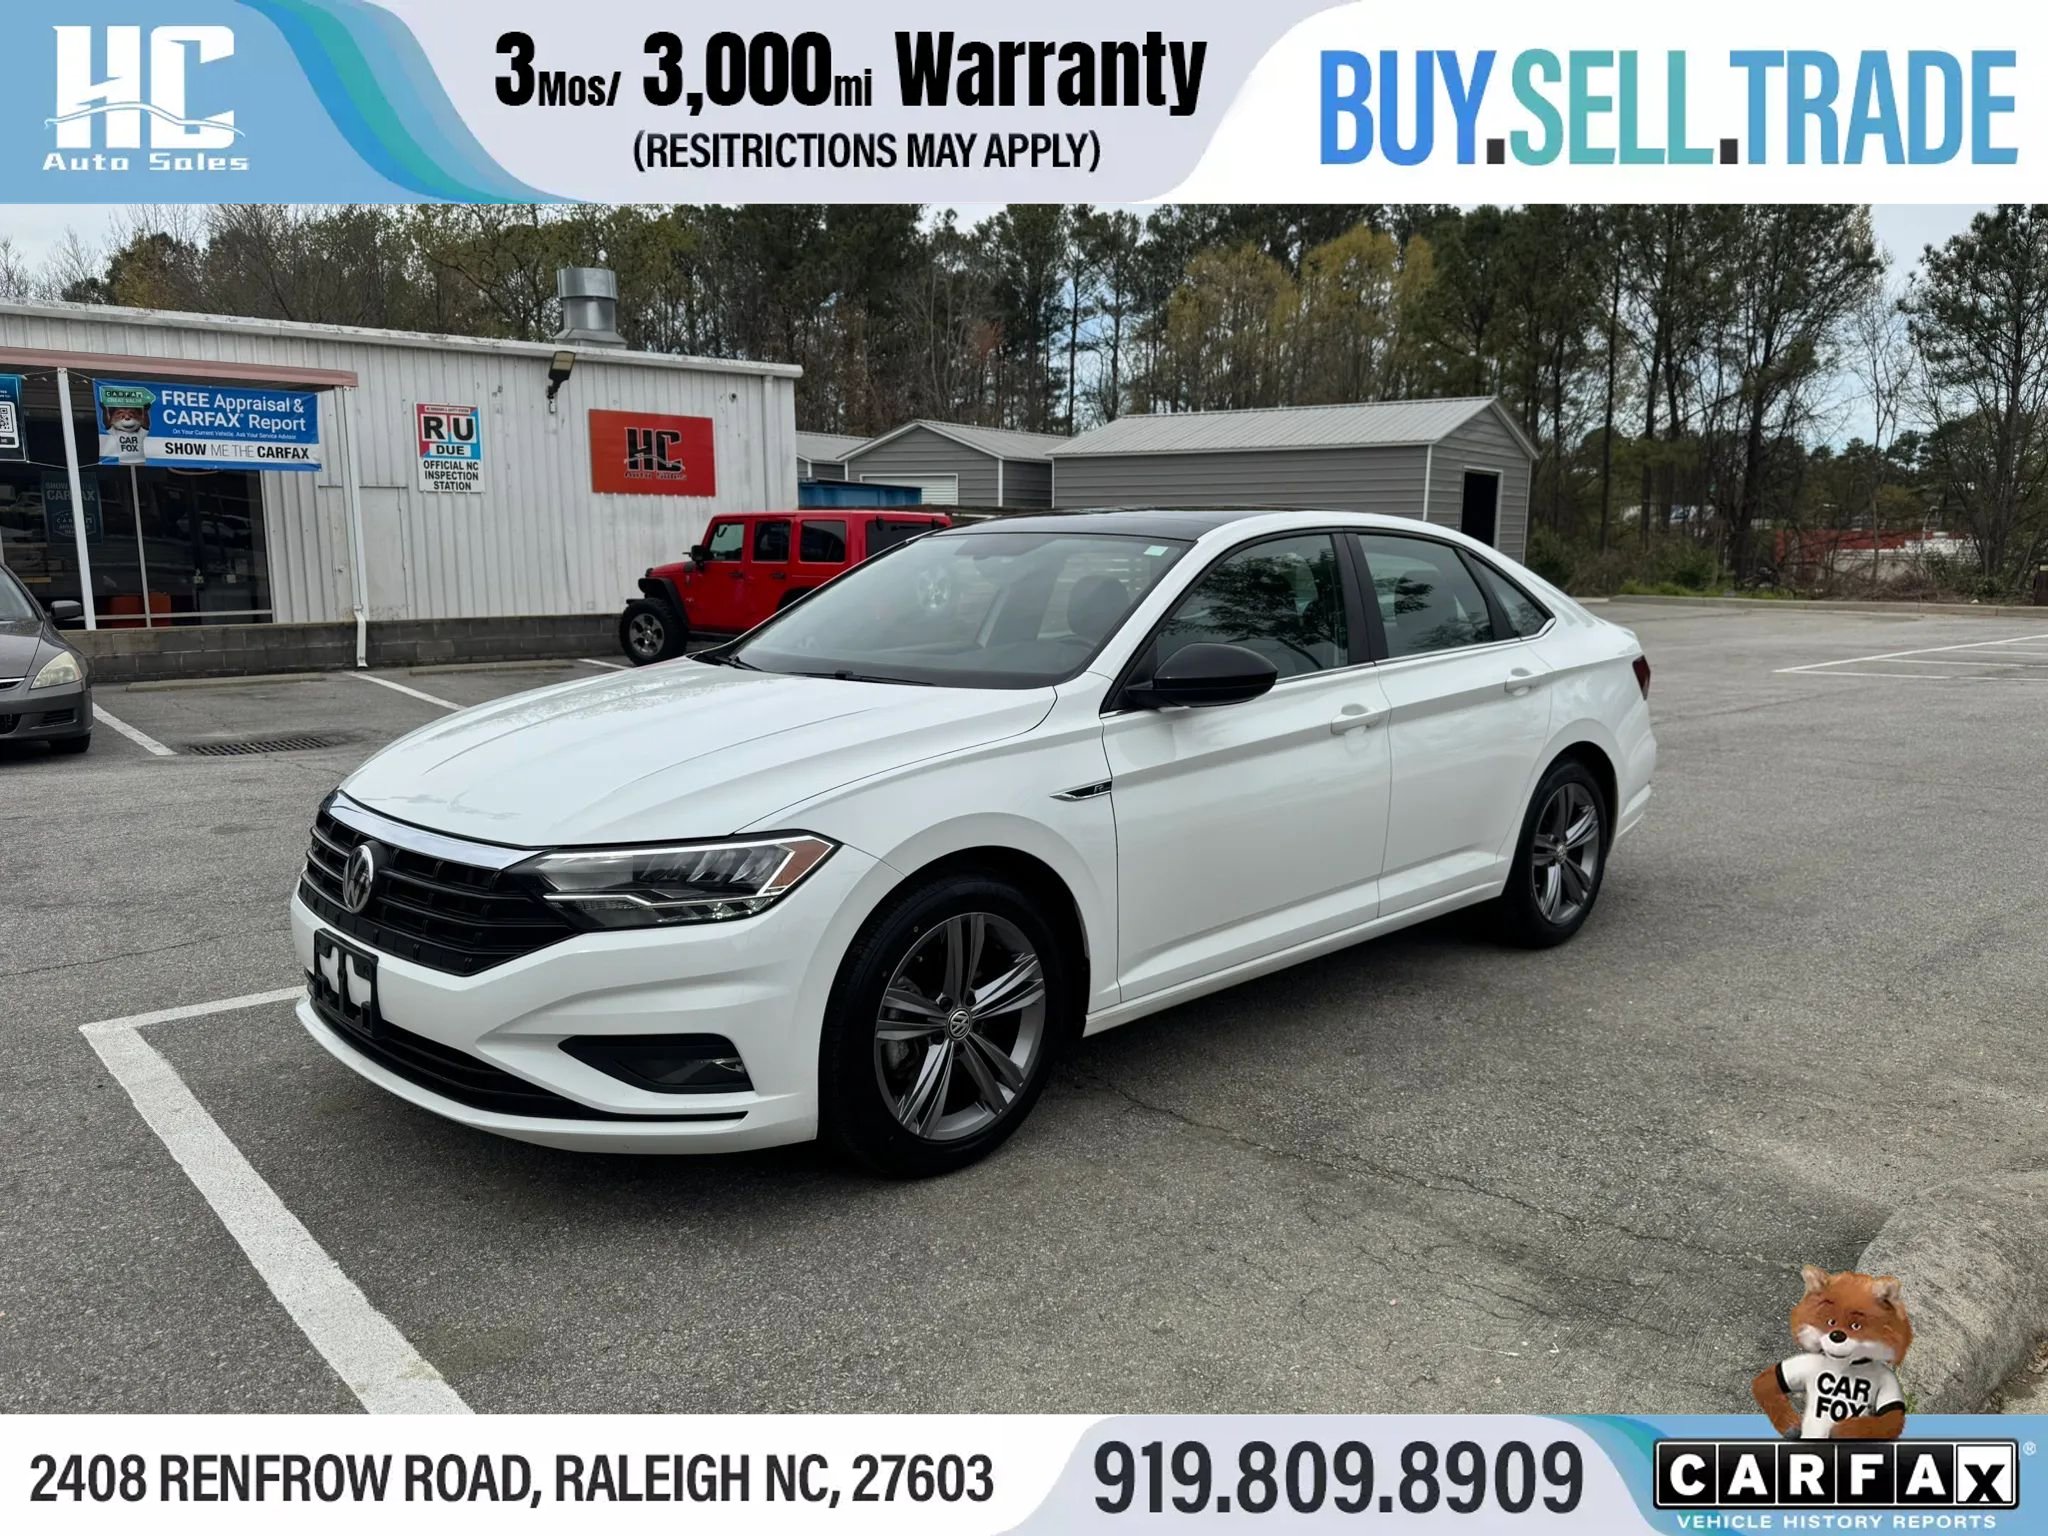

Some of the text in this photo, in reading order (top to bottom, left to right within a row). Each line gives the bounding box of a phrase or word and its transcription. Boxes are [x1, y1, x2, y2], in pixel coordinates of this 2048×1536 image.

[161, 390, 304, 414] FREE Appraisal &
[249, 415, 306, 433] Report
[423, 415, 474, 441] R U
[119, 435, 138, 444] CAR
[120, 444, 139, 453] FOX
[164, 441, 310, 460] SHOW ME THE CARFAX
[436, 444, 465, 455] DUE
[624, 427, 684, 473] HC
[423, 460, 479, 471] OFFICIAL NC
[425, 470, 479, 481] INSPECTION
[433, 481, 472, 491] STATION
